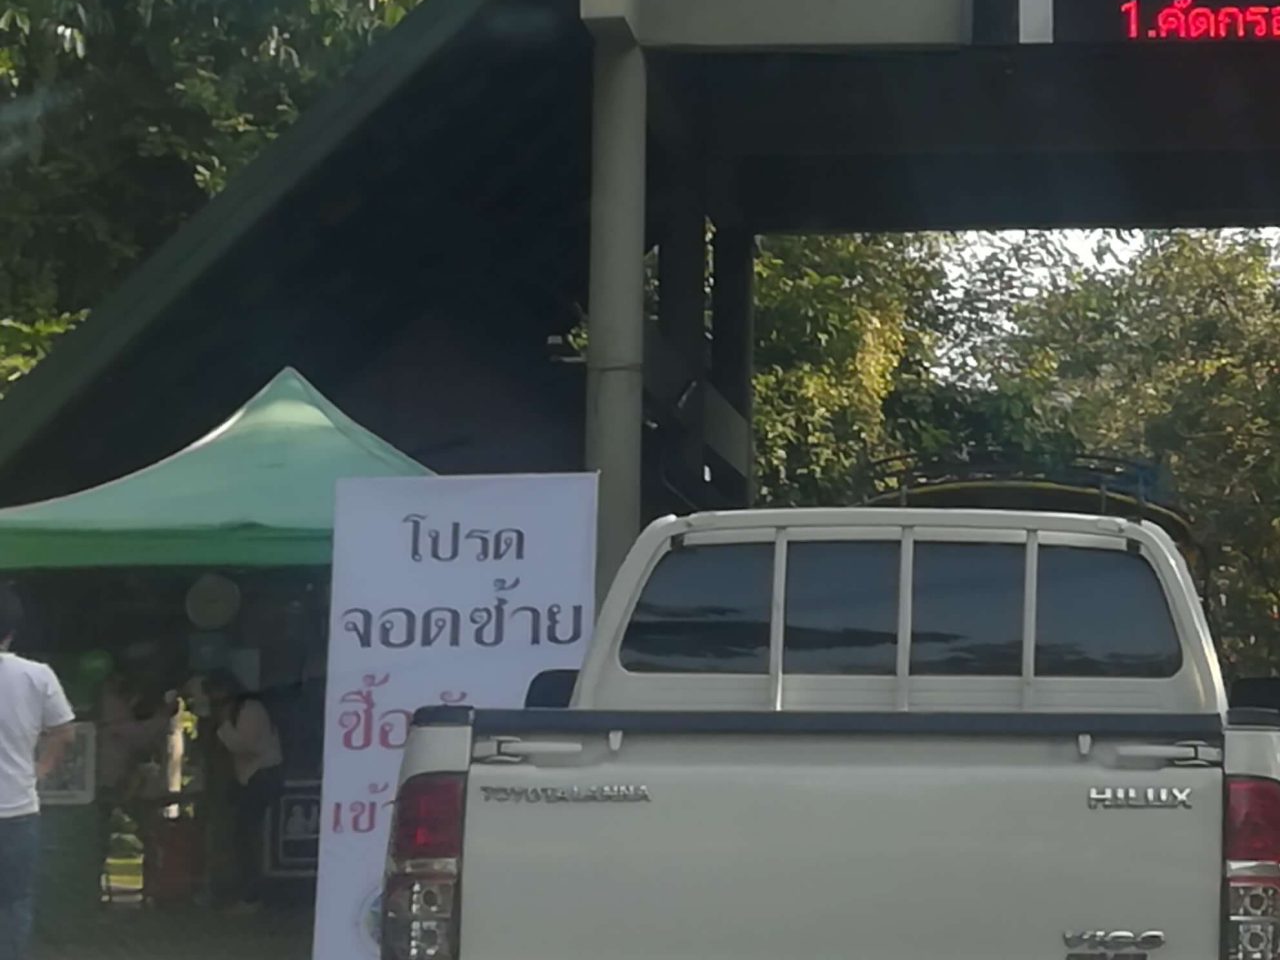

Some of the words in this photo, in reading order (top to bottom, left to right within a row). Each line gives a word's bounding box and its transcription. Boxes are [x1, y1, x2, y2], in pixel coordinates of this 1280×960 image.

[403, 513, 527, 562] โปรด
[341, 577, 584, 649] จอดซ้าย
[331, 782, 397, 834] เข้
[1087, 787, 1193, 810] HILUX
